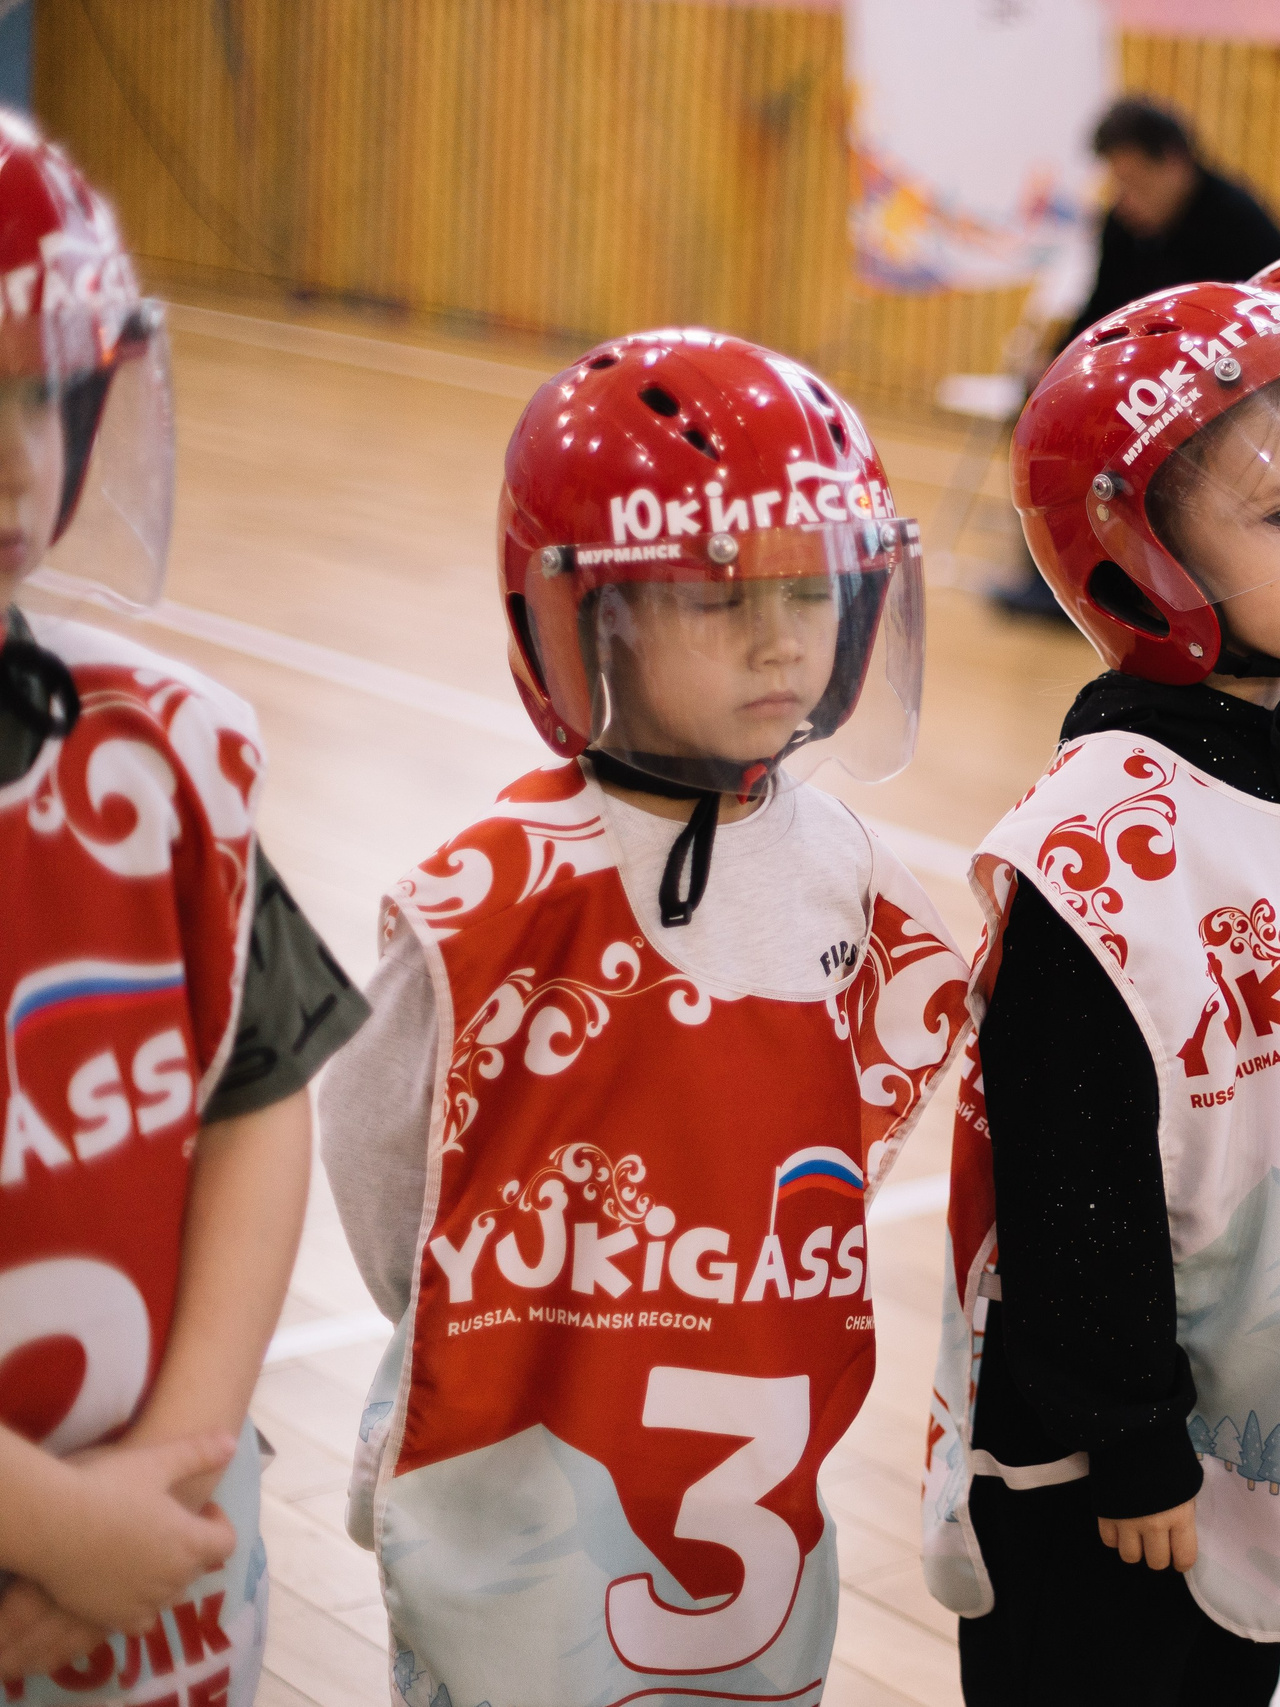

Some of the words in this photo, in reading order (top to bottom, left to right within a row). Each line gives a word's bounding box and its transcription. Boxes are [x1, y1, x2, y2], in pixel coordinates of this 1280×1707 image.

[1121, 386, 1203, 466] МУРМАНСК
[576, 543, 682, 567] МУРМАНСК
[1189, 1085, 1236, 1109] RUSS
[447, 1307, 522, 1337] RUSSIA,
[528, 1306, 635, 1330] MURMANSK
[637, 1311, 713, 1332] REGION
[604, 1365, 811, 1676] 3
